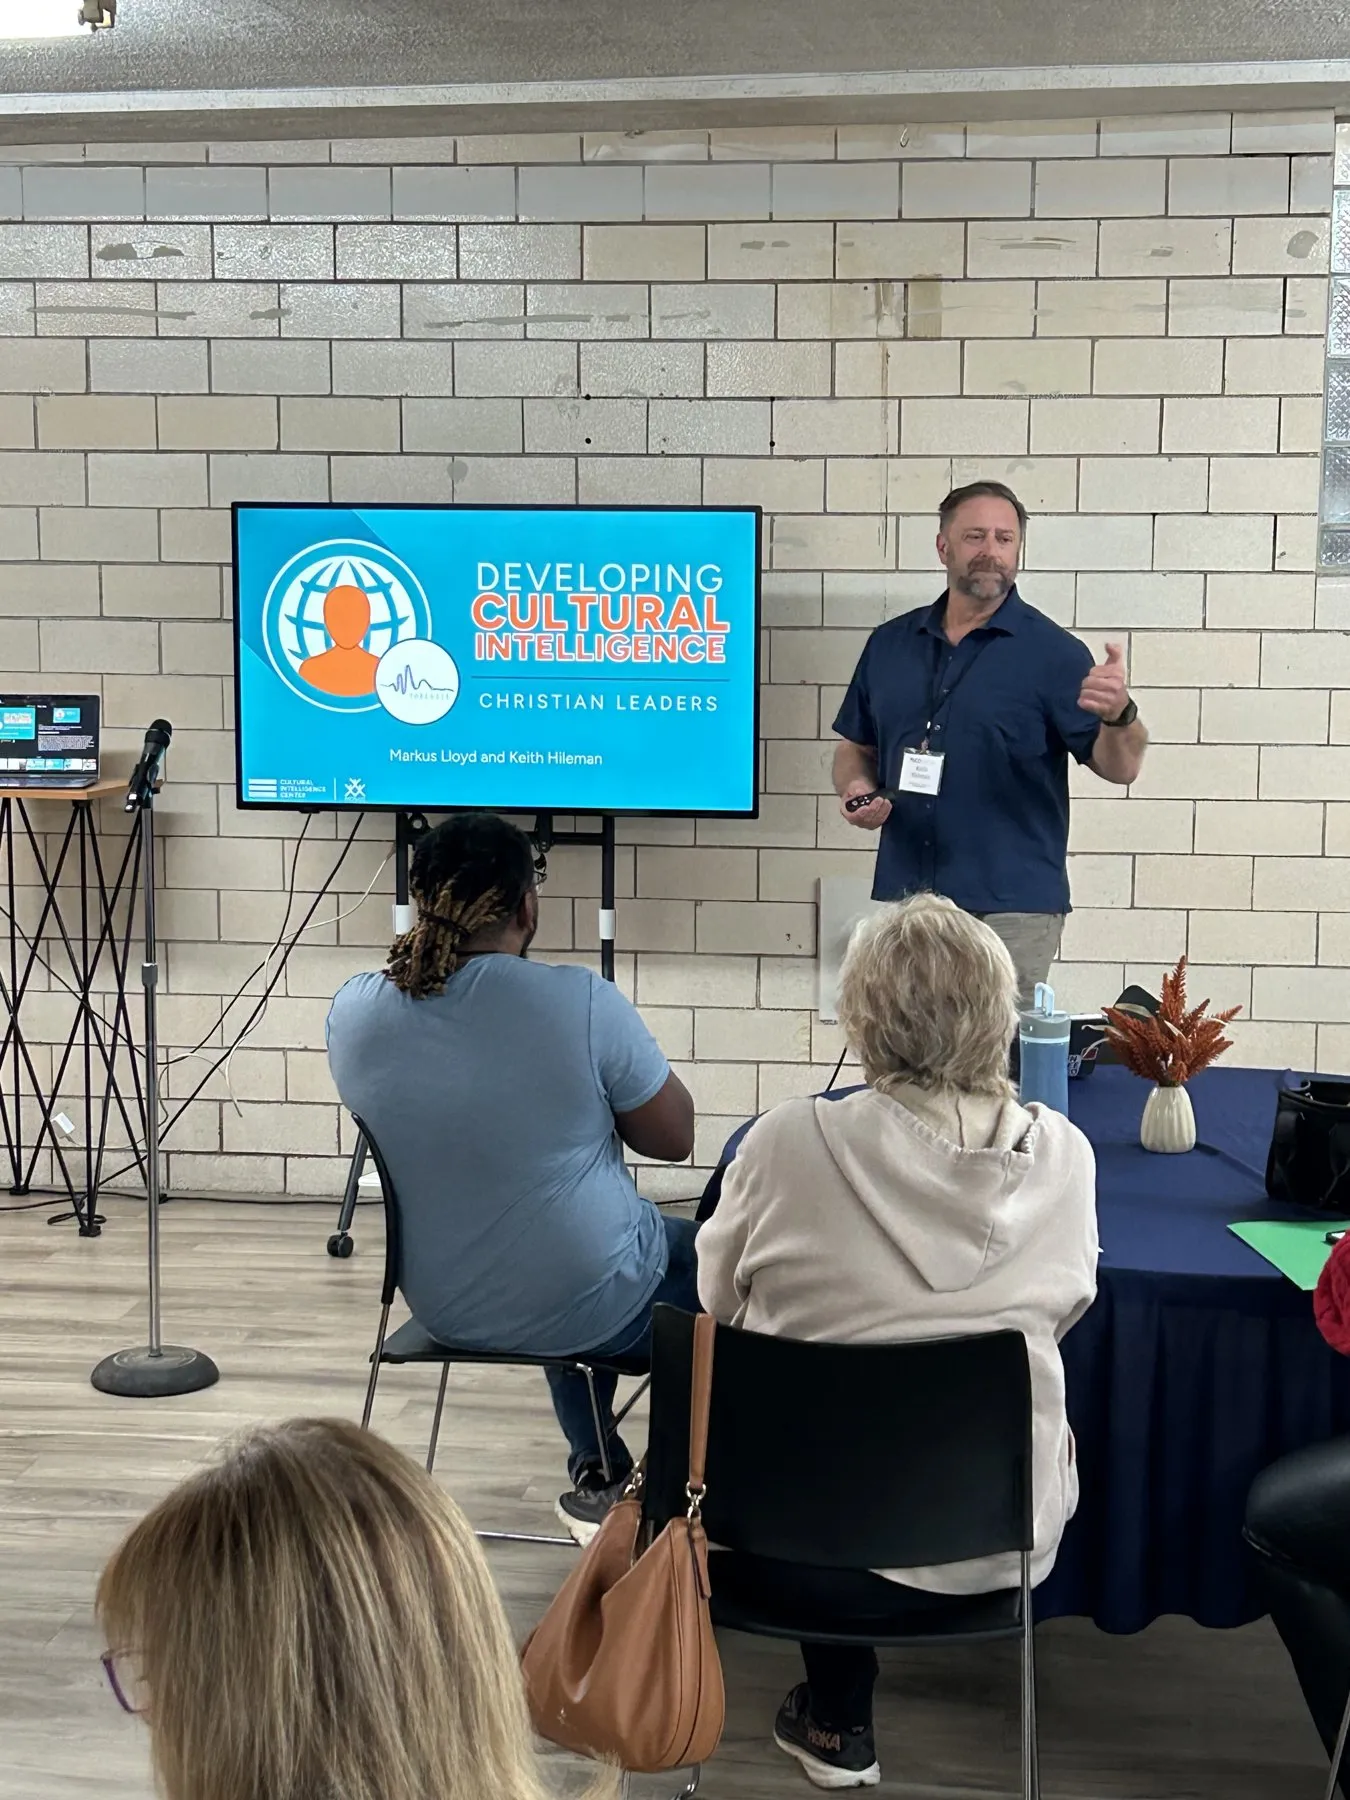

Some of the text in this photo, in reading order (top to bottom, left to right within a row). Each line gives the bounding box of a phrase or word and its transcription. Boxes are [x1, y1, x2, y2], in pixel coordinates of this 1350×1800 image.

[477, 562, 723, 593] DEVELOPING
[471, 591, 730, 634] CULTURAL
[475, 632, 726, 663] INTELLIGENCE
[479, 692, 718, 712] CHRISTIAN LEADERS
[389, 748, 603, 766] Markus Lloyd and Keith Hileman
[280, 785, 327, 793] INTELLIGENCE
